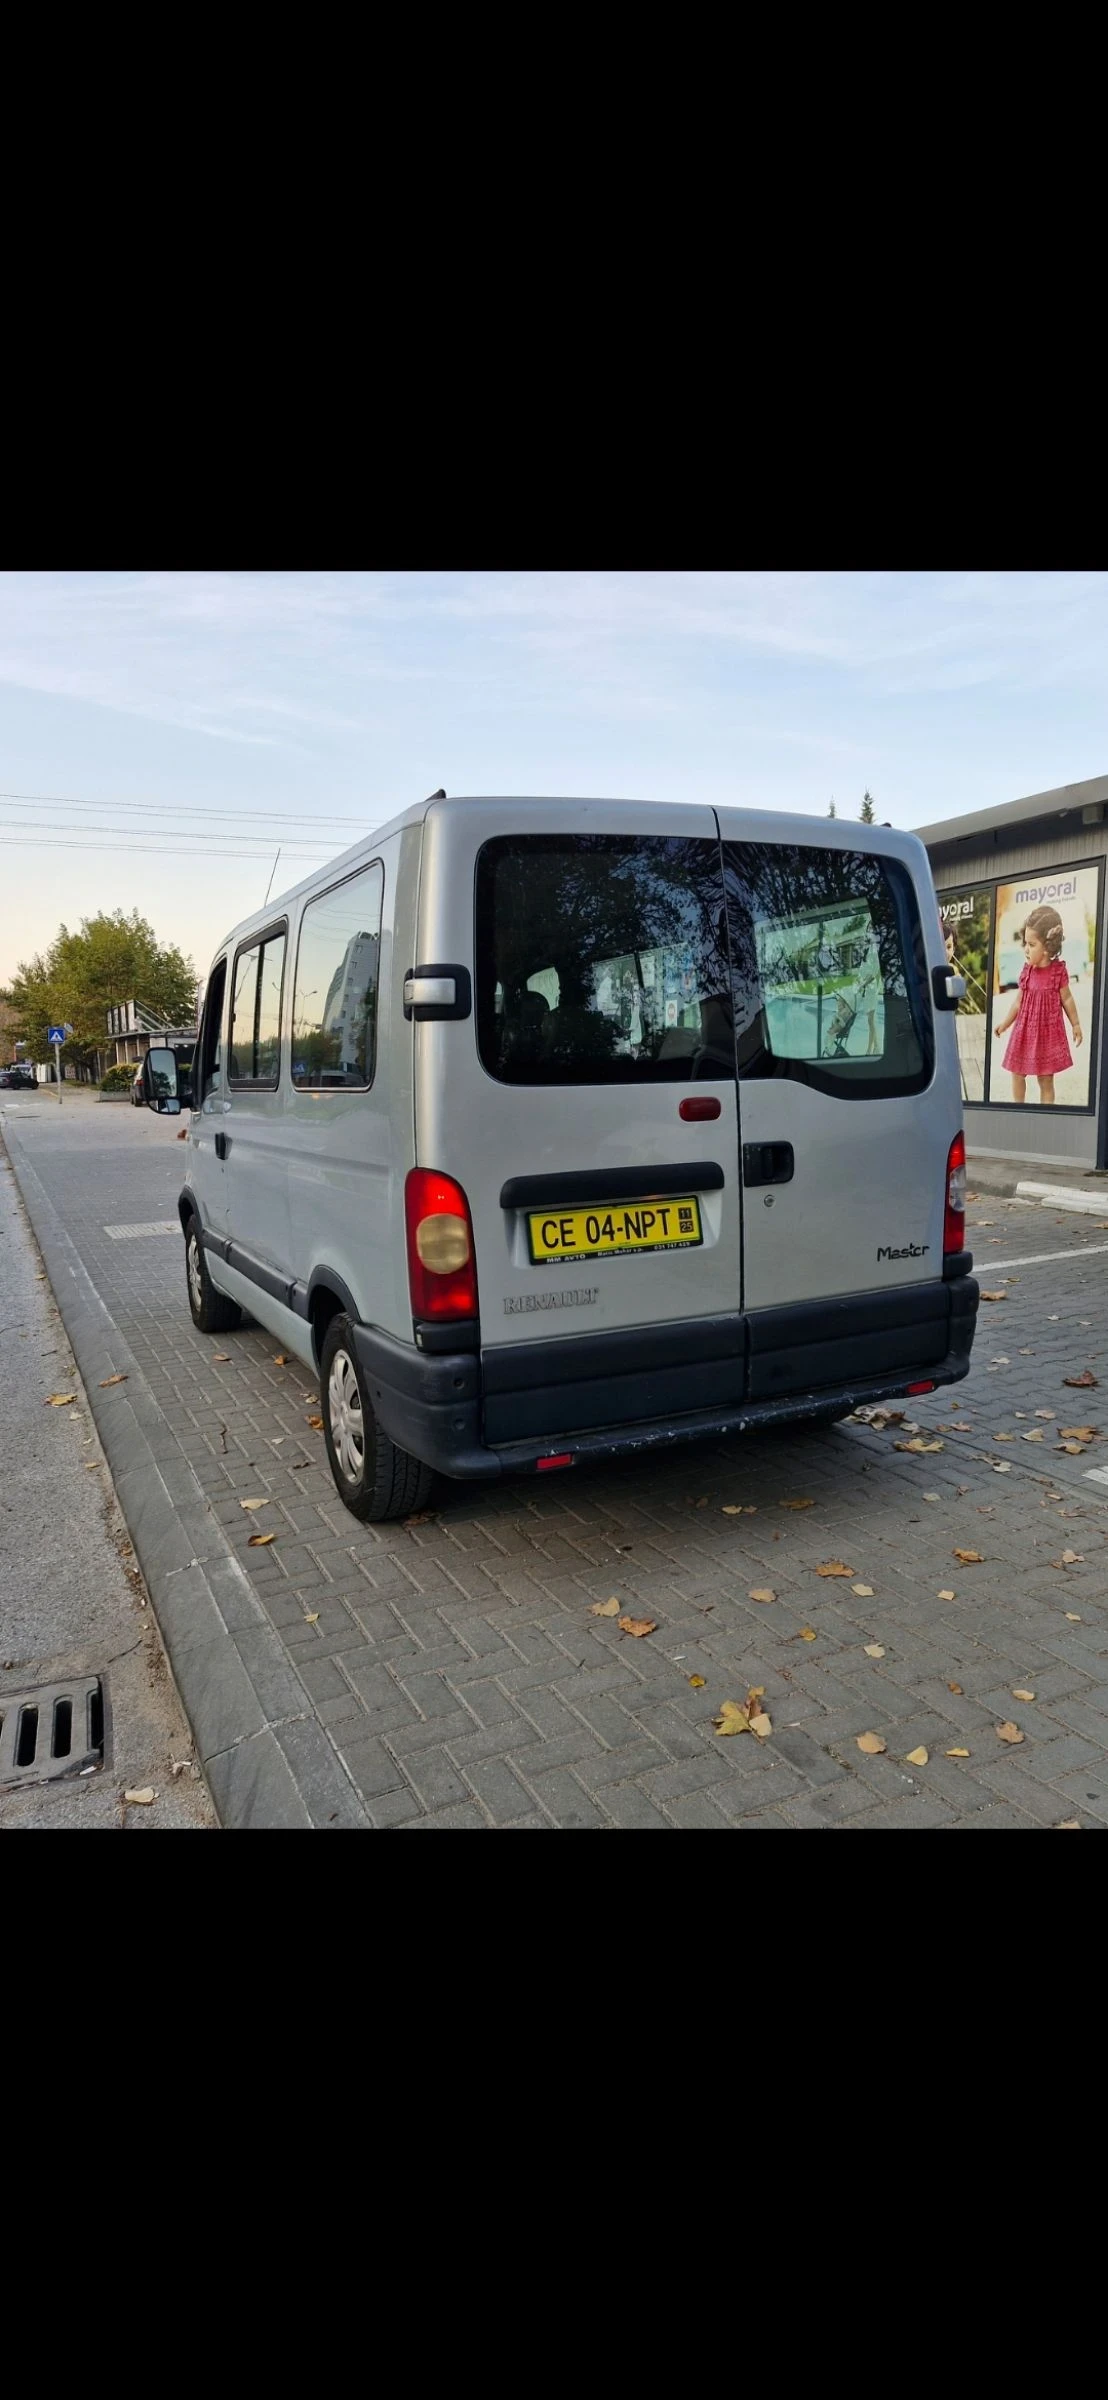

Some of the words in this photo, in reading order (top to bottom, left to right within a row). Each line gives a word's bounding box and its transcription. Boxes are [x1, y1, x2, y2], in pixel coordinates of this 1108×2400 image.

[1016, 877, 1077, 904] mayoral
[938, 896, 974, 921] yoral
[680, 1209, 690, 1219] 11
[681, 1222, 693, 1232] 25
[541, 1218, 576, 1249] CE
[585, 1208, 671, 1244] 04-NPT
[503, 1287, 599, 1314] RENAULT
